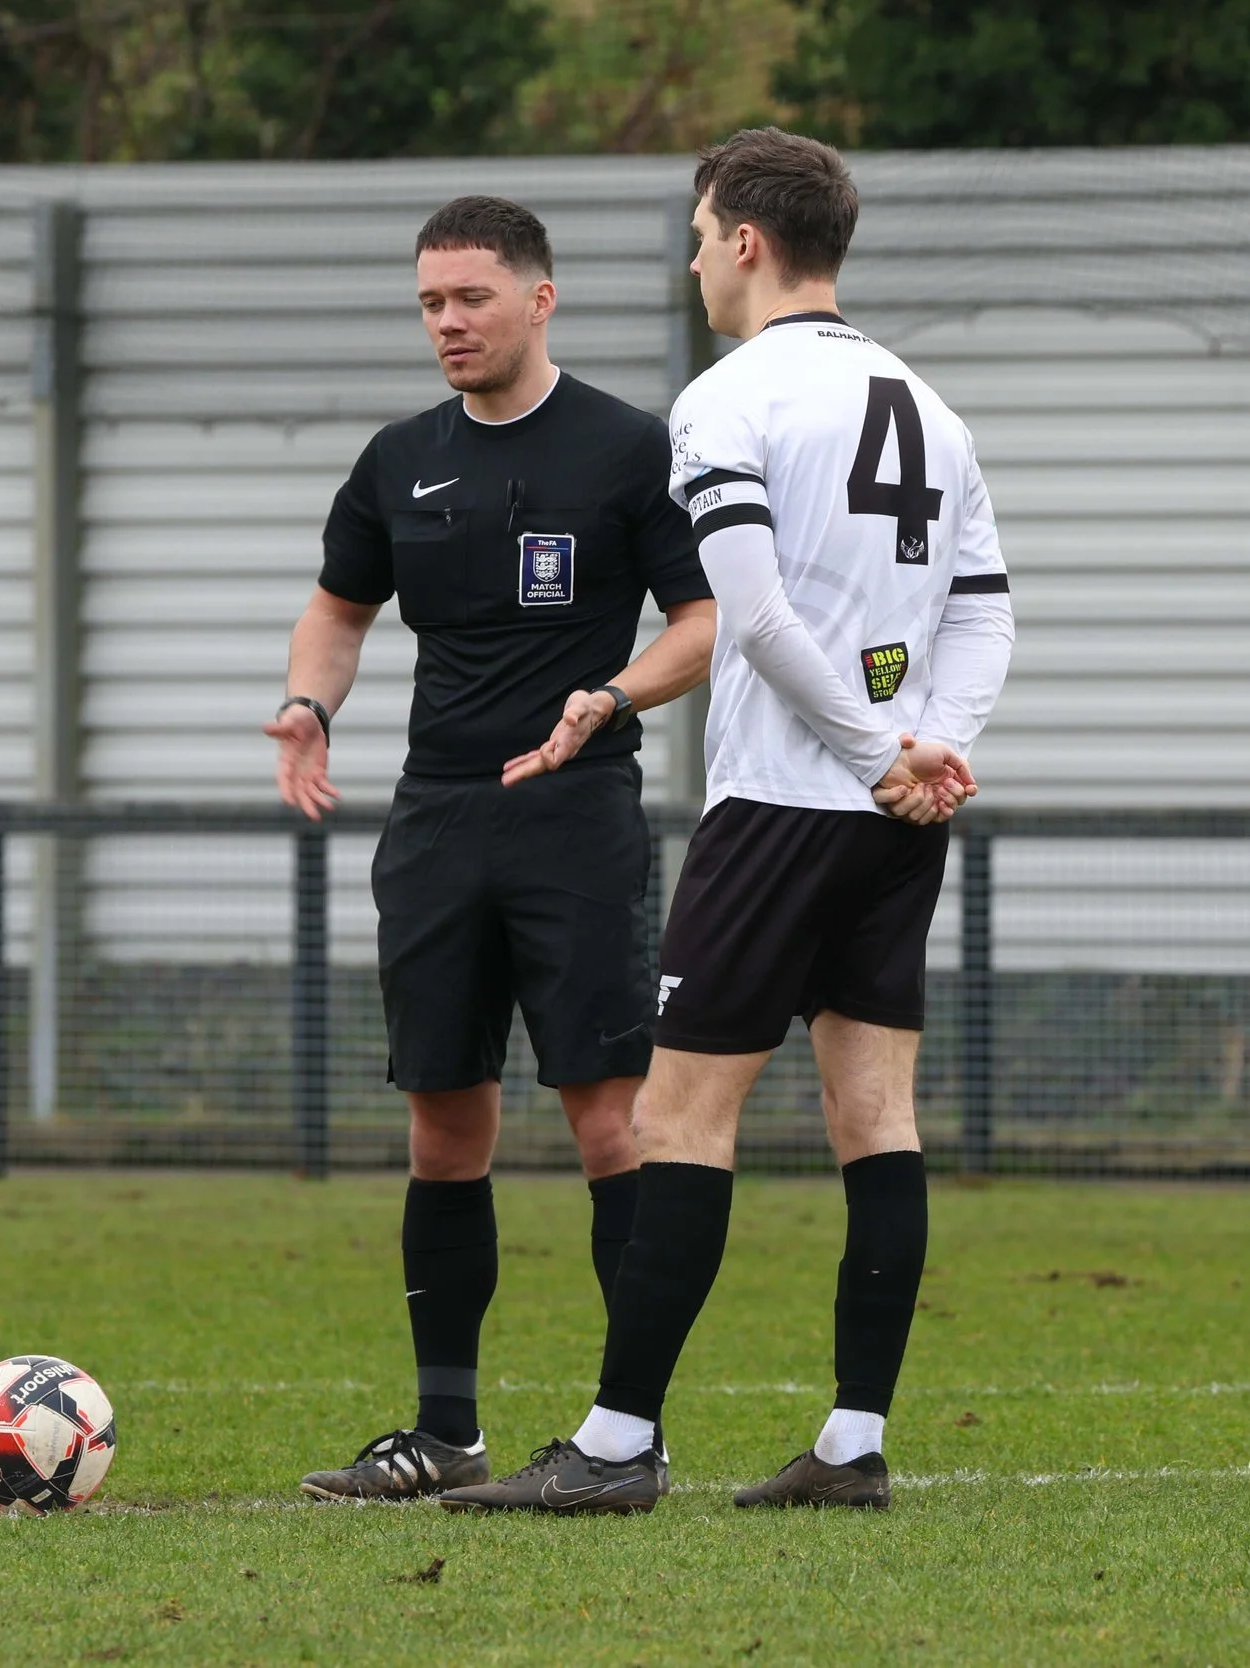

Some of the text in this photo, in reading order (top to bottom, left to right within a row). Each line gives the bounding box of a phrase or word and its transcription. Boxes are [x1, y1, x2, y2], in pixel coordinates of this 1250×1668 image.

[817, 330, 861, 342] BALHAM
[846, 375, 945, 566] 4
[689, 487, 723, 519] APTAIN
[872, 648, 905, 666] BIG
[869, 663, 902, 677] YELLOW
[10, 1364, 76, 1404] uhlsport
